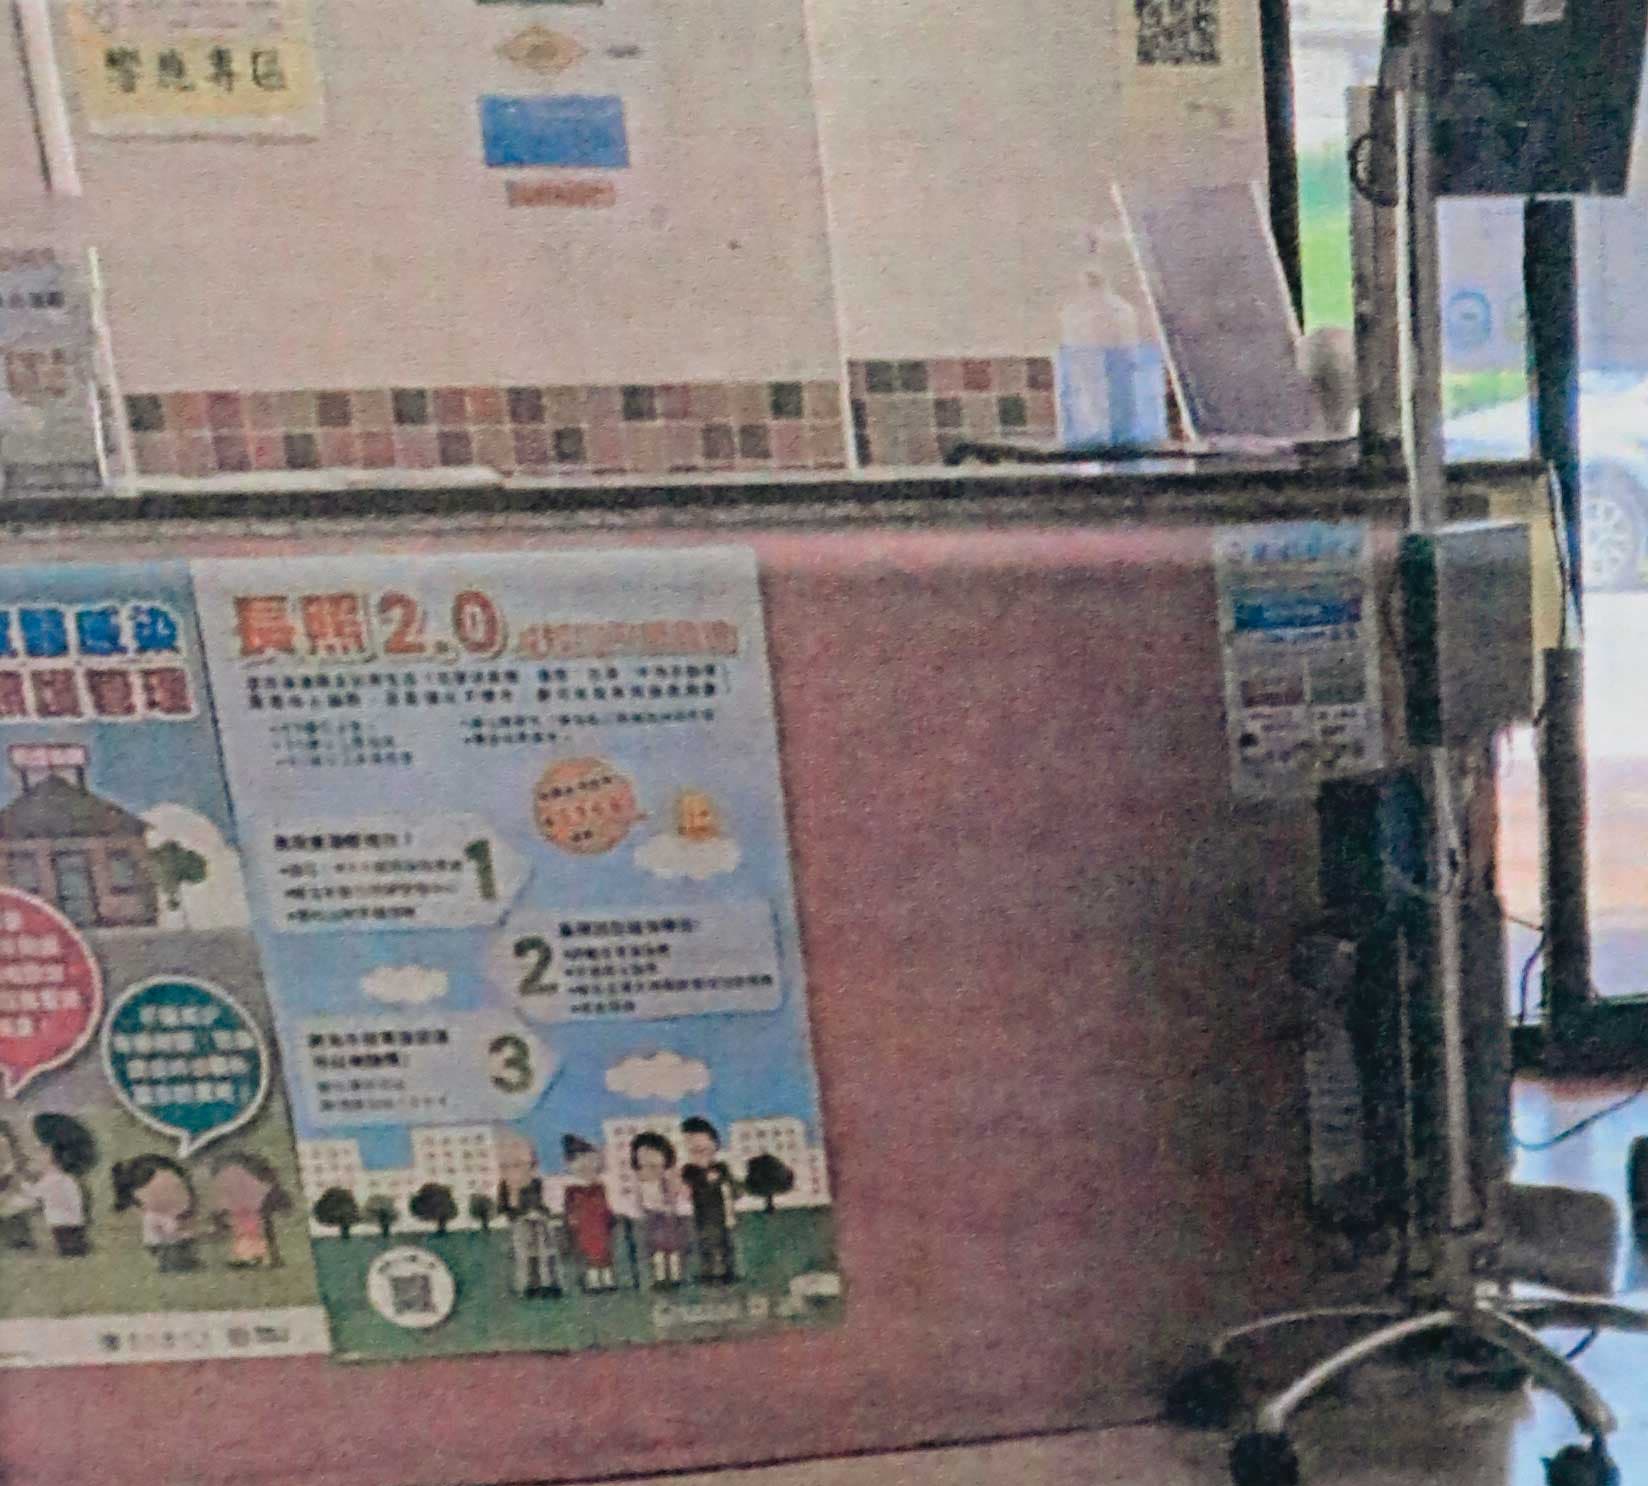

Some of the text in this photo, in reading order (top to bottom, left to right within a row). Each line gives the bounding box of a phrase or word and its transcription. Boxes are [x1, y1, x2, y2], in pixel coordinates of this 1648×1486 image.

[463, 839, 497, 902] 1
[513, 936, 558, 997] 2
[488, 1034, 533, 1095] 3
